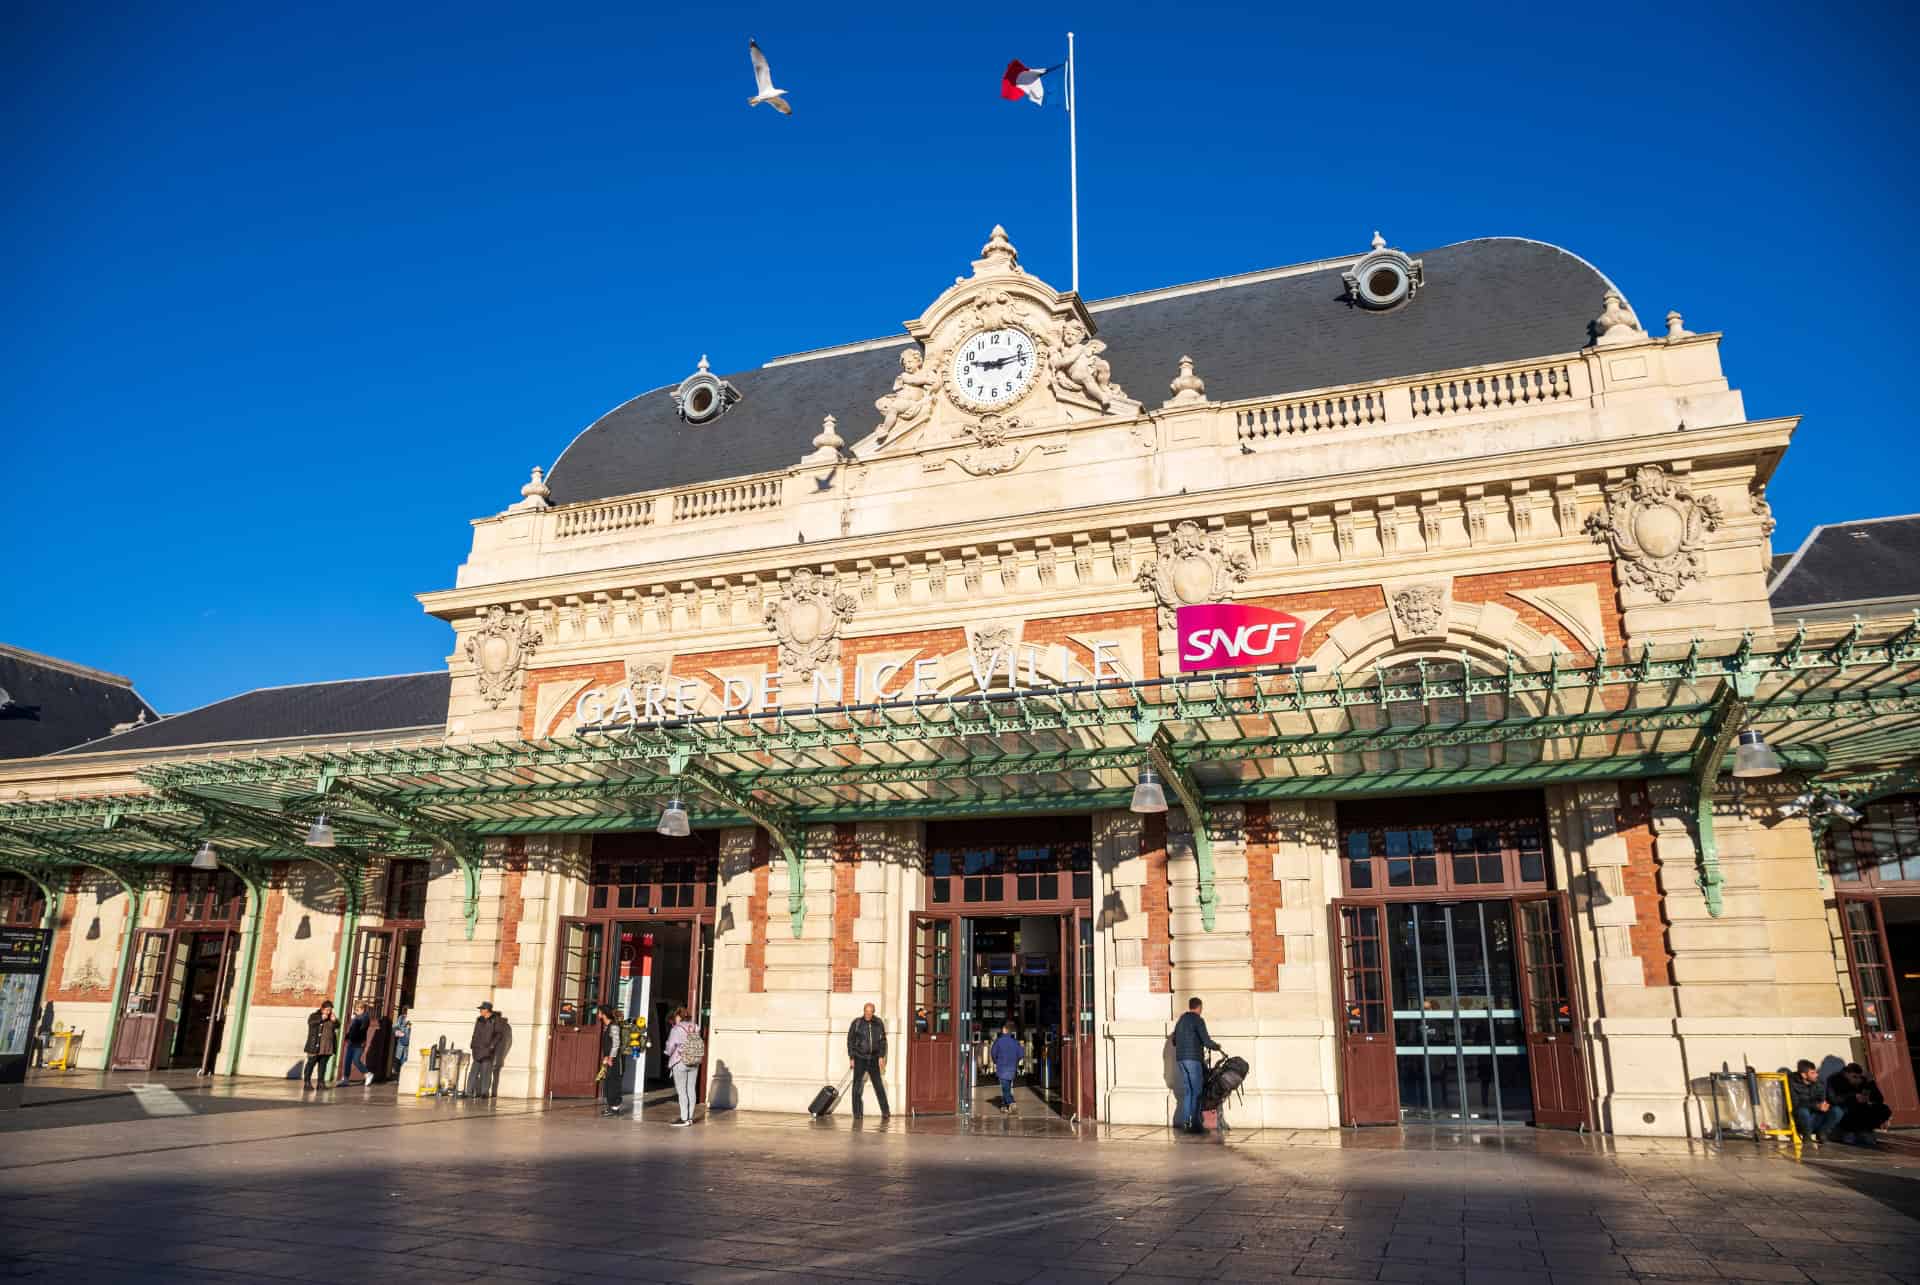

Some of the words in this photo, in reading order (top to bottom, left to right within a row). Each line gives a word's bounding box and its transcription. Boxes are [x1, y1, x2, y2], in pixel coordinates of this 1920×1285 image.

[990, 334, 1000, 345] 12
[1008, 336, 1010, 346] 1
[978, 340, 985, 350] 11
[1017, 344, 1023, 354] 2
[966, 351, 975, 361] 10
[964, 366, 970, 375] 9
[1016, 370, 1023, 379] 4
[967, 378, 973, 388] 8
[1006, 381, 1012, 392] 5
[978, 386, 984, 396] 7
[991, 387, 998, 398] 6
[1183, 621, 1297, 662] SNCF
[575, 680, 698, 723] GARE
[723, 672, 785, 713] DE
[812, 658, 939, 706] NICE
[968, 640, 1120, 691] VILLE
